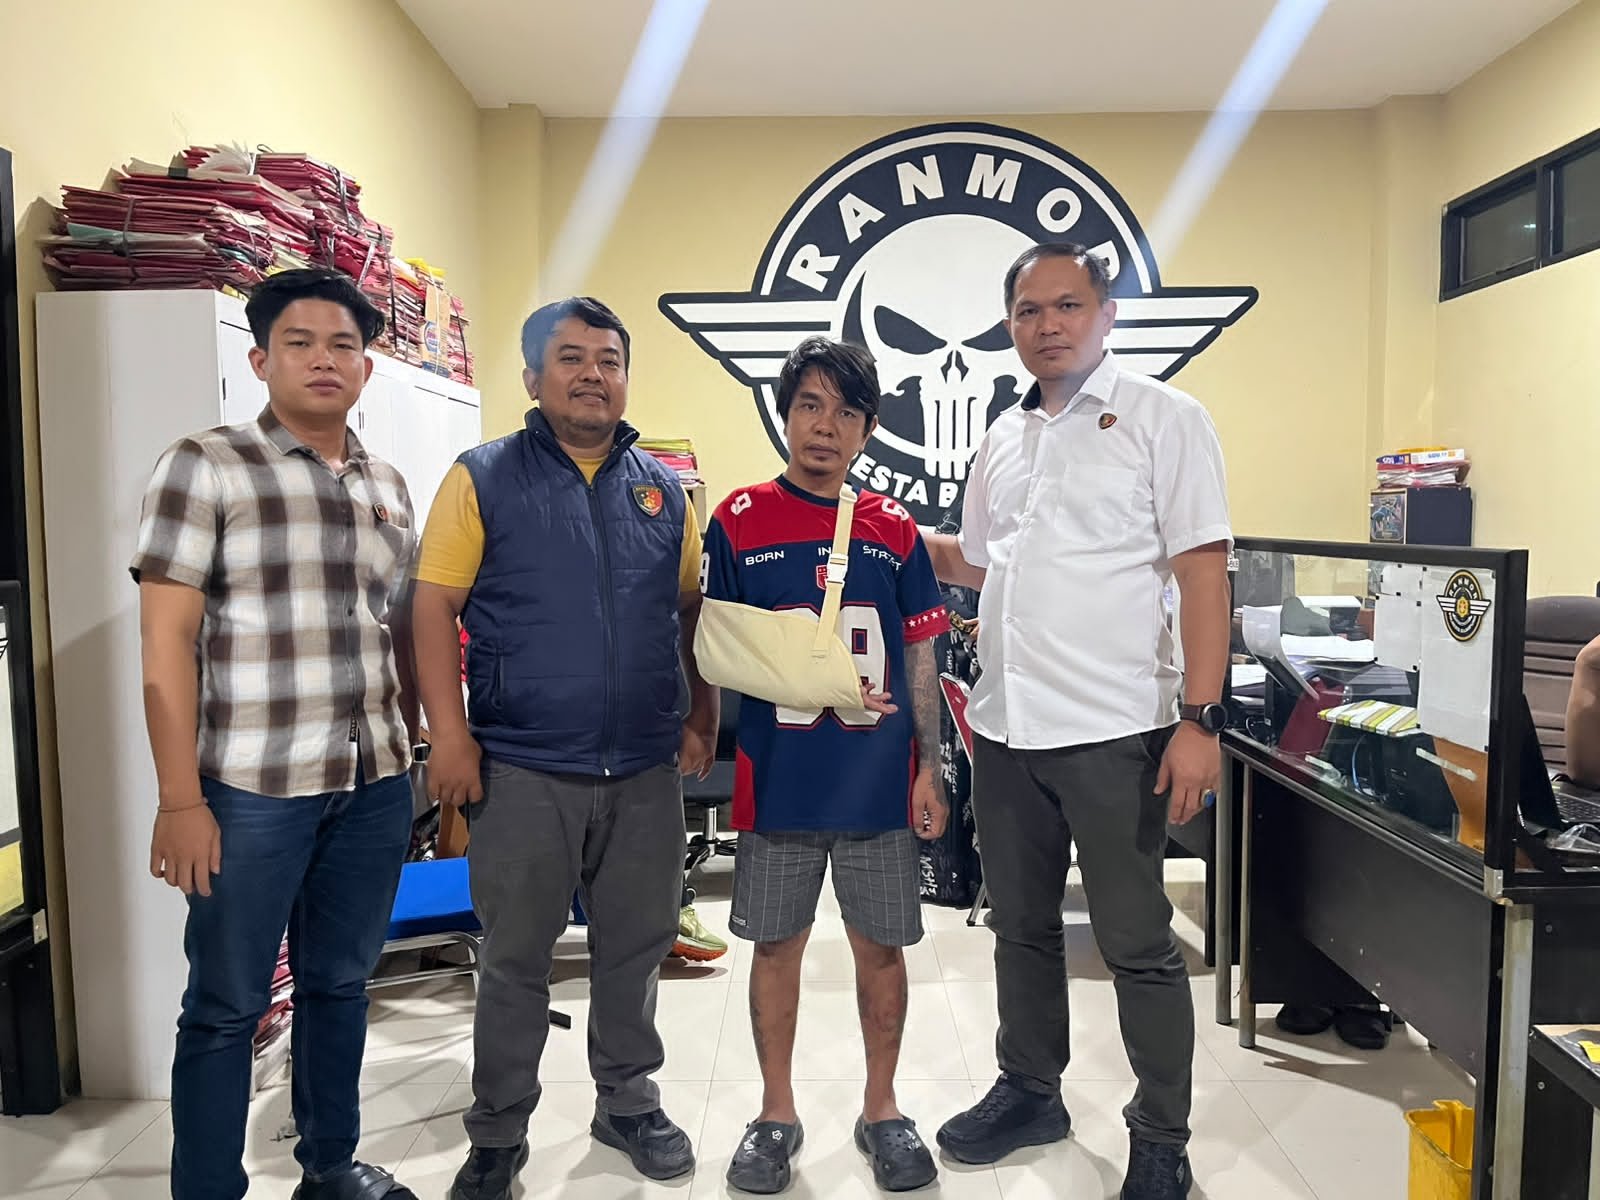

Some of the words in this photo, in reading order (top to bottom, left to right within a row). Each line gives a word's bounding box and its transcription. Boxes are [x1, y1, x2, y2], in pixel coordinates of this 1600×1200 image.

[848, 452, 929, 506] ESTA
[938, 481, 959, 508] B
[745, 551, 785, 566] BORN
[817, 546, 832, 556] IN
